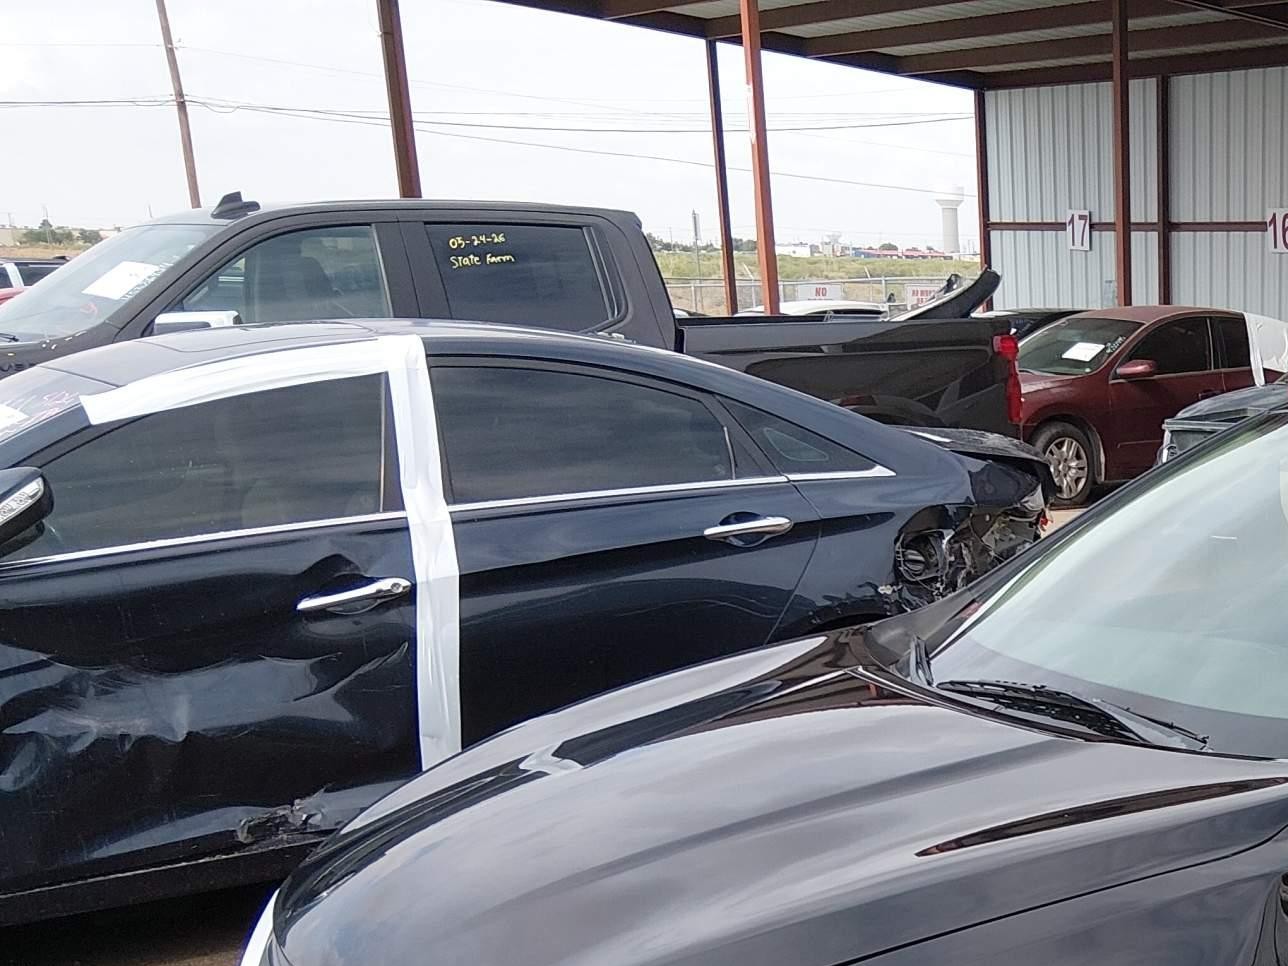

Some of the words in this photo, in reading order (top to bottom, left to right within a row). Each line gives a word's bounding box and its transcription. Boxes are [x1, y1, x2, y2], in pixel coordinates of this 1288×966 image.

[1068, 214, 1088, 246] 17
[449, 233, 506, 249] 05-24-26
[450, 254, 481, 269] State
